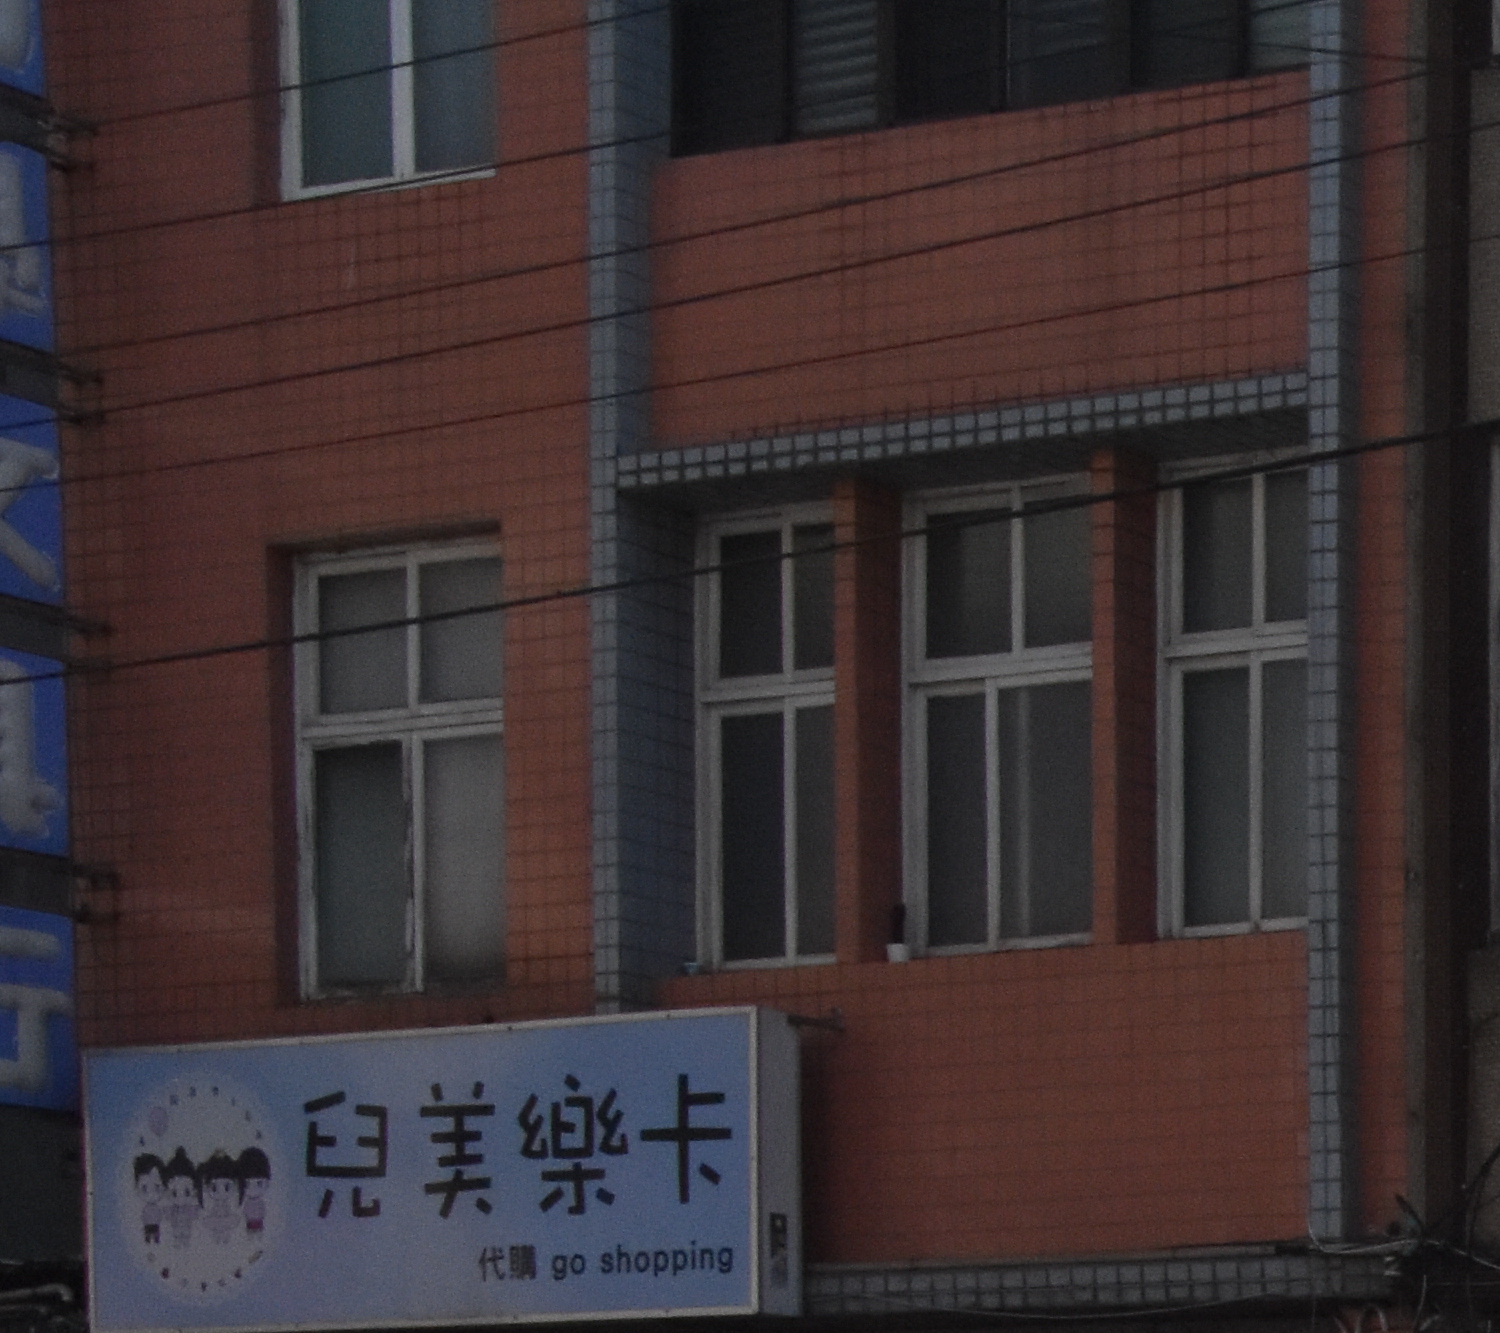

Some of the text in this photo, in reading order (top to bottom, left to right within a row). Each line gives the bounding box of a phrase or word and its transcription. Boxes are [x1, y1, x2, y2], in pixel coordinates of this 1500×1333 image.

[478, 1242, 734, 1284] 代購 go shopping
